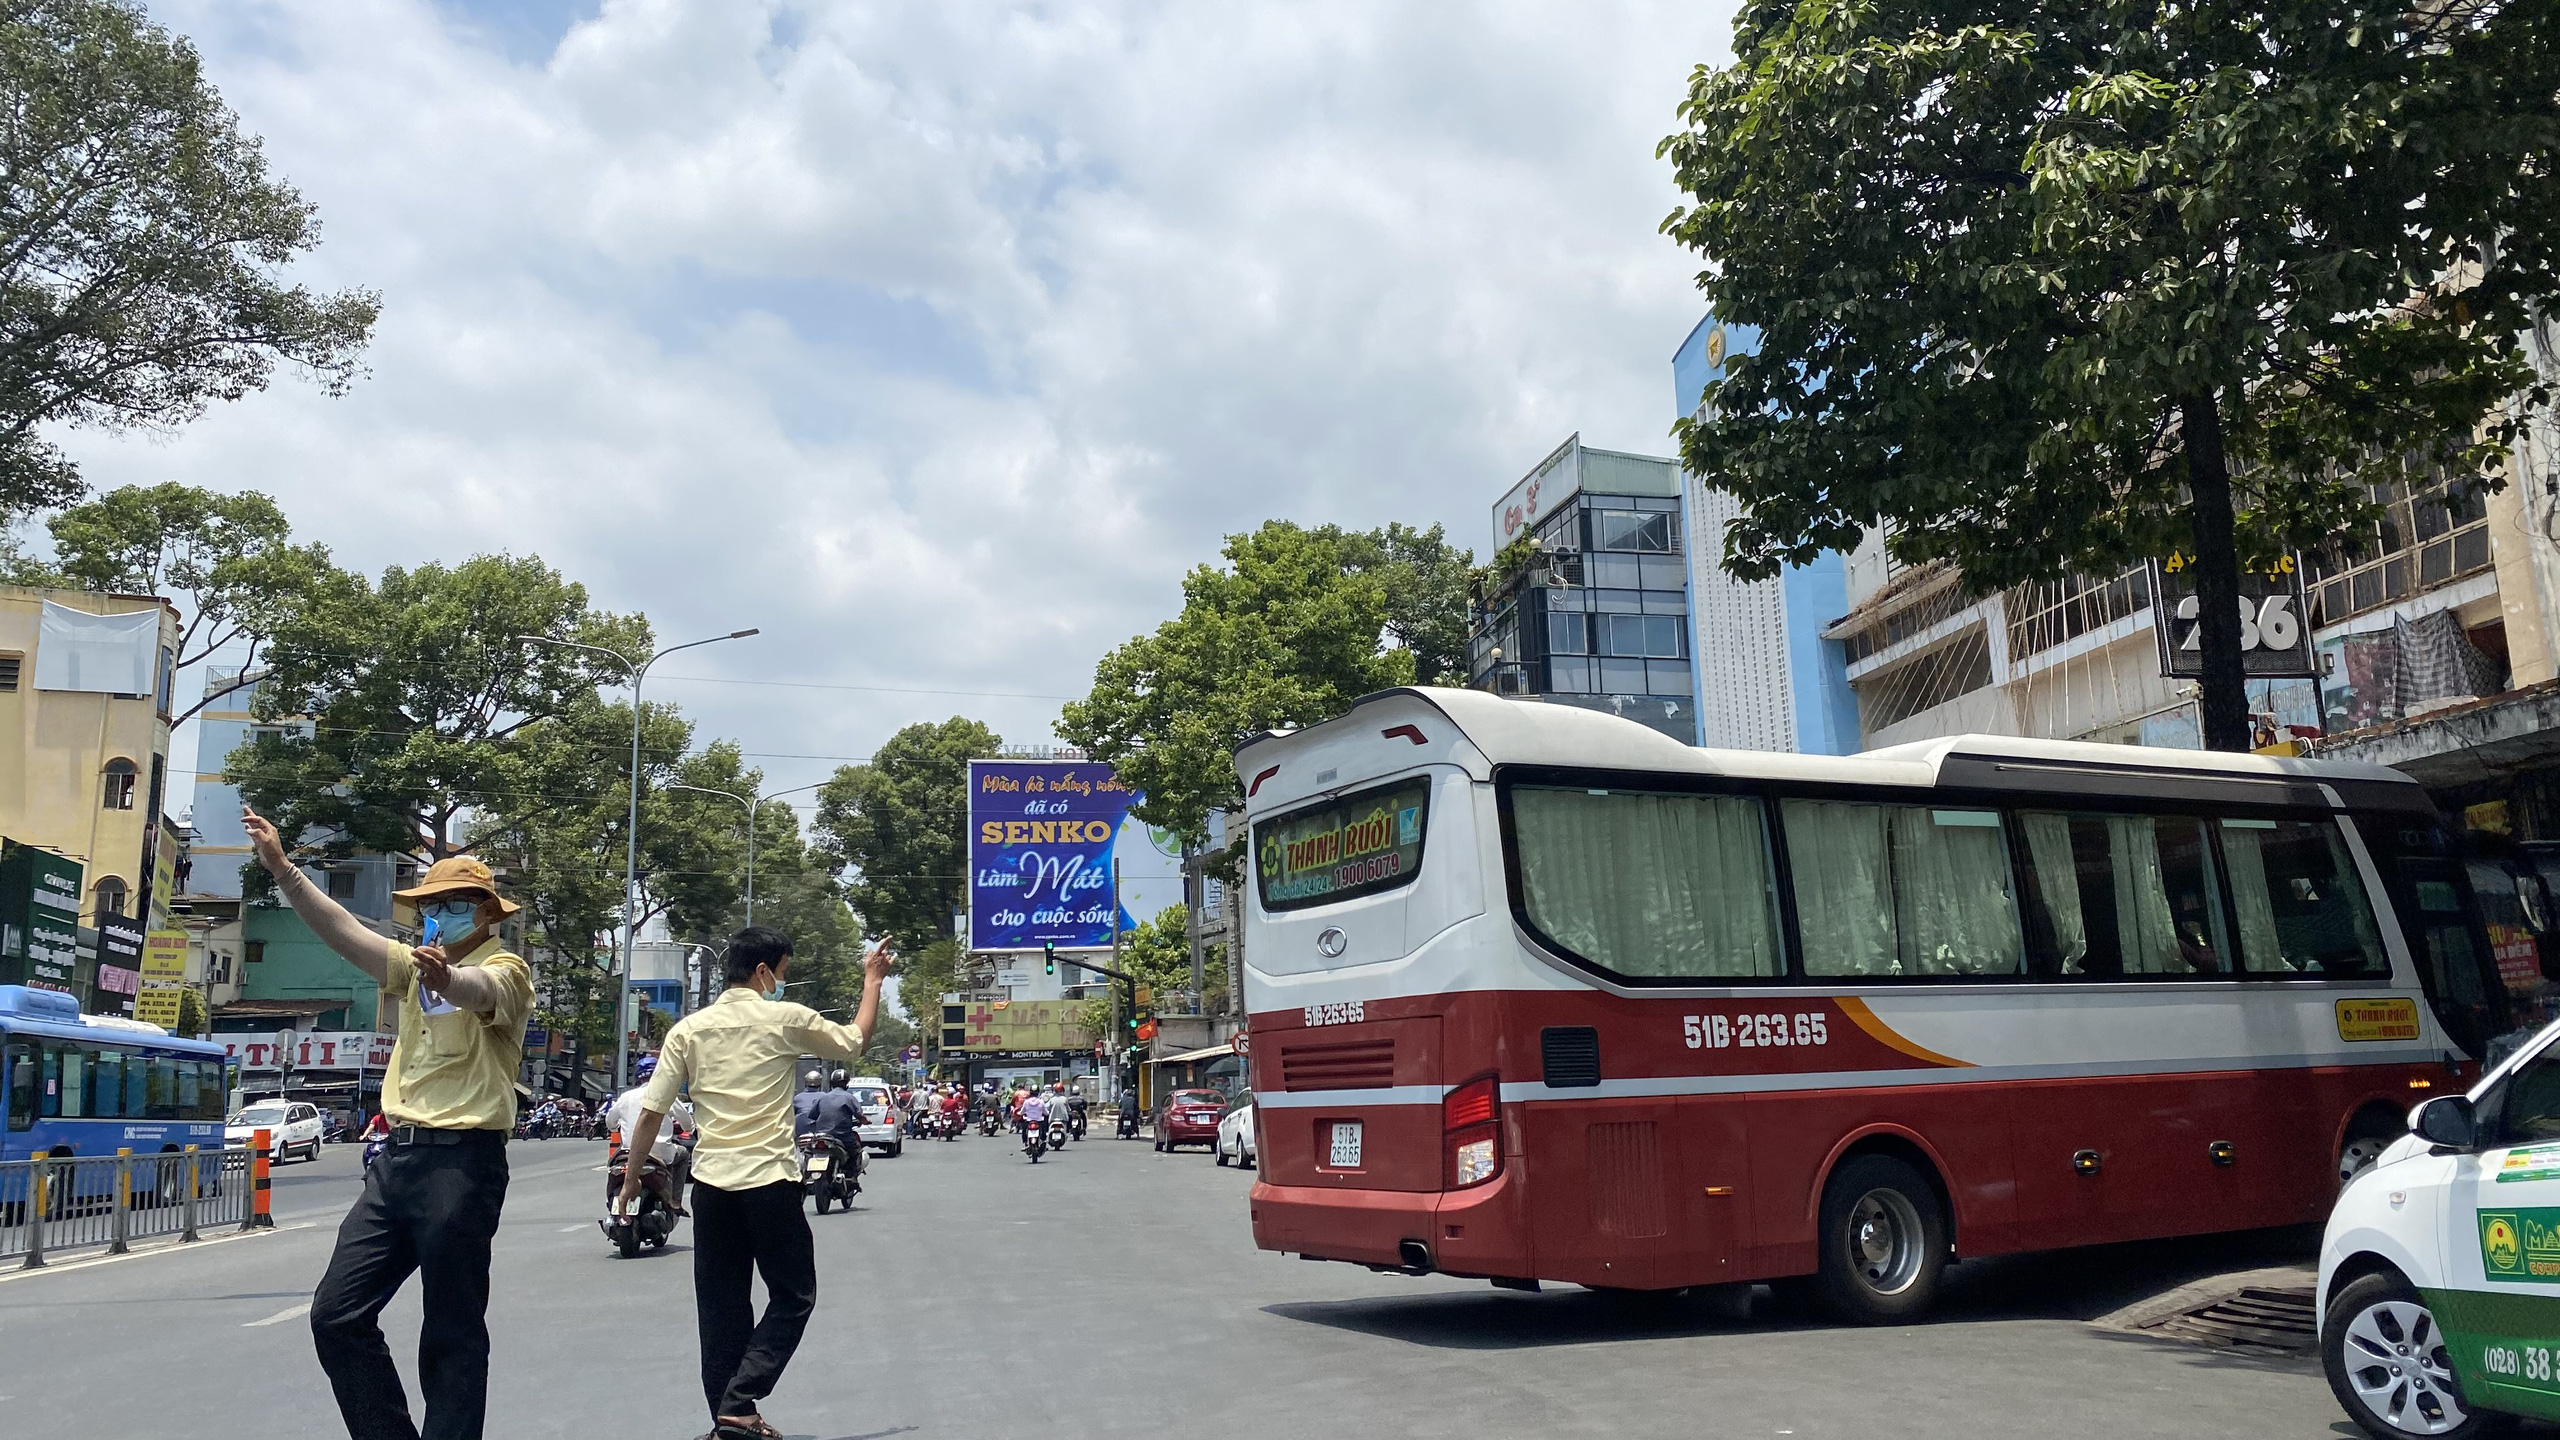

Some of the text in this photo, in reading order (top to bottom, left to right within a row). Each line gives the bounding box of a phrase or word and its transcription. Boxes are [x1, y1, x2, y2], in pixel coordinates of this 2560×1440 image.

[983, 774, 1020, 793] Mùa
[1024, 775, 1044, 793] hè
[1050, 771, 1091, 796] nắng
[1024, 799, 1068, 815] đã có
[981, 820, 1111, 844] SENKO
[978, 851, 1104, 902] Làm Mát
[1335, 863, 1365, 889] 1900
[1366, 853, 1400, 881] 6079
[991, 904, 1119, 927] cho cuộc sống
[965, 1035, 1002, 1046] OPTIC
[1338, 1127, 1355, 1145] 51B
[2485, 1346, 2520, 1377] (028)
[2526, 1347, 2551, 1381] 38
